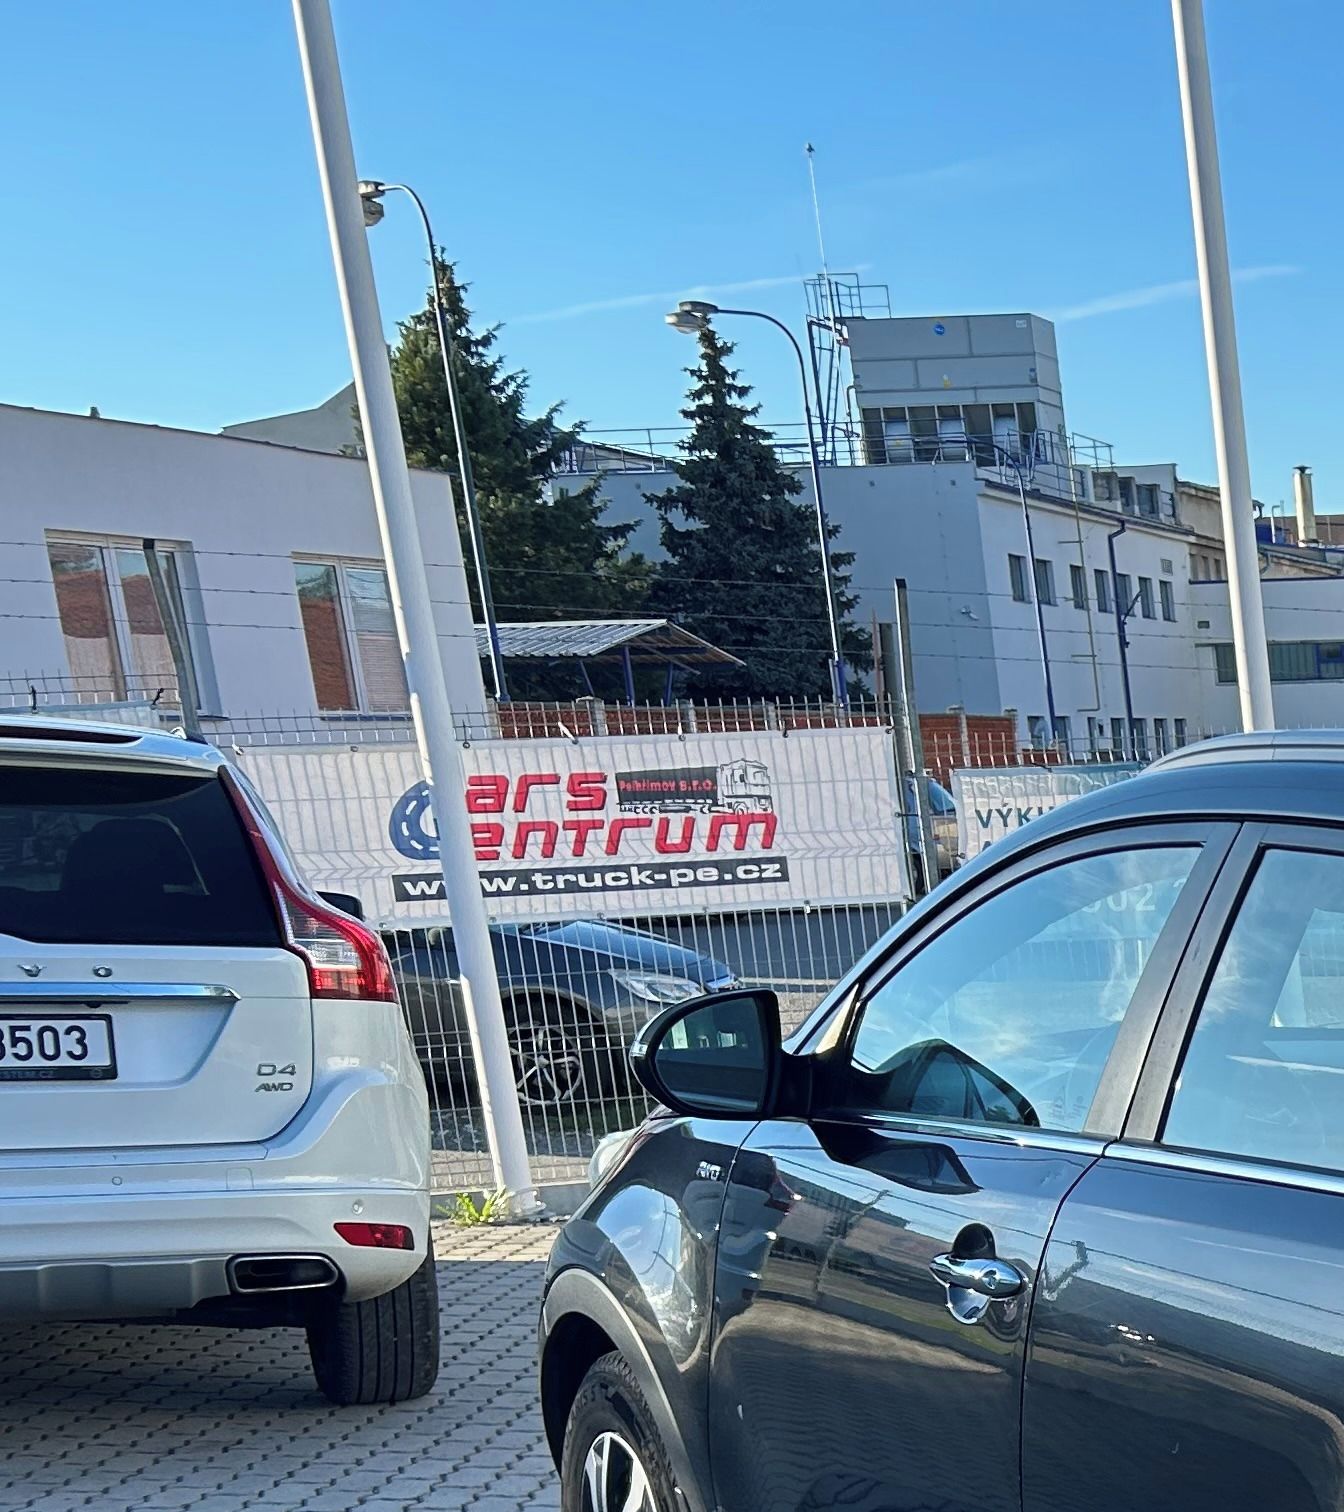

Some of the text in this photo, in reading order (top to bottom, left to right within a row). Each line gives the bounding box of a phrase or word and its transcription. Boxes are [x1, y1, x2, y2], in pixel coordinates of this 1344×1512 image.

[402, 862, 783, 897] ww.truck-pe.cz
[0, 1025, 88, 1061] 503
[257, 1063, 297, 1077] D4
[255, 1082, 293, 1092] AWD
